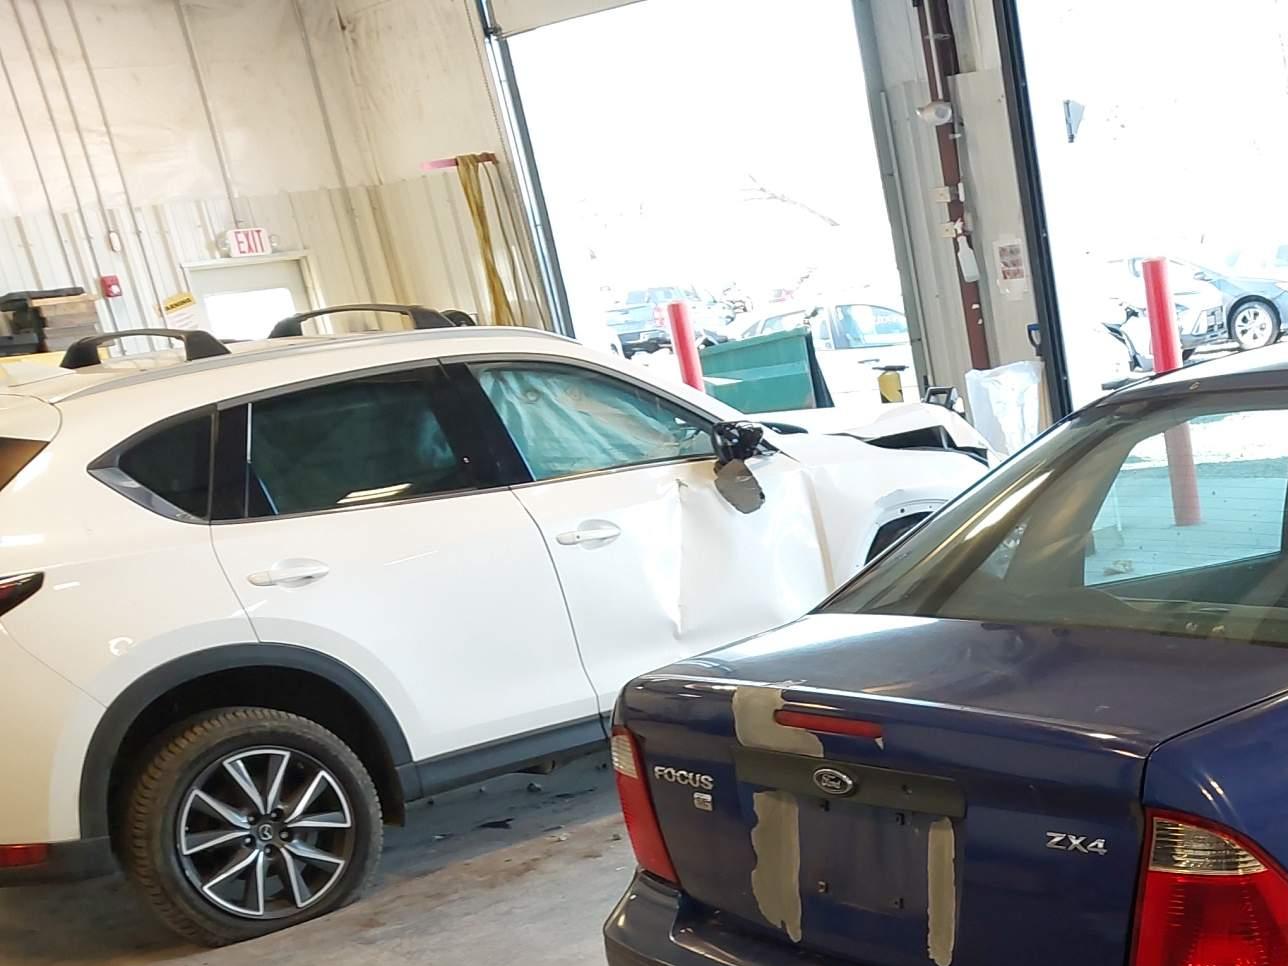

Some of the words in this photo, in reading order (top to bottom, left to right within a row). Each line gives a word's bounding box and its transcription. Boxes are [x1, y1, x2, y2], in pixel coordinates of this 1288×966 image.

[233, 229, 265, 254] EXIT
[653, 765, 714, 790] FOCUS
[1045, 831, 1108, 855] ZX4
